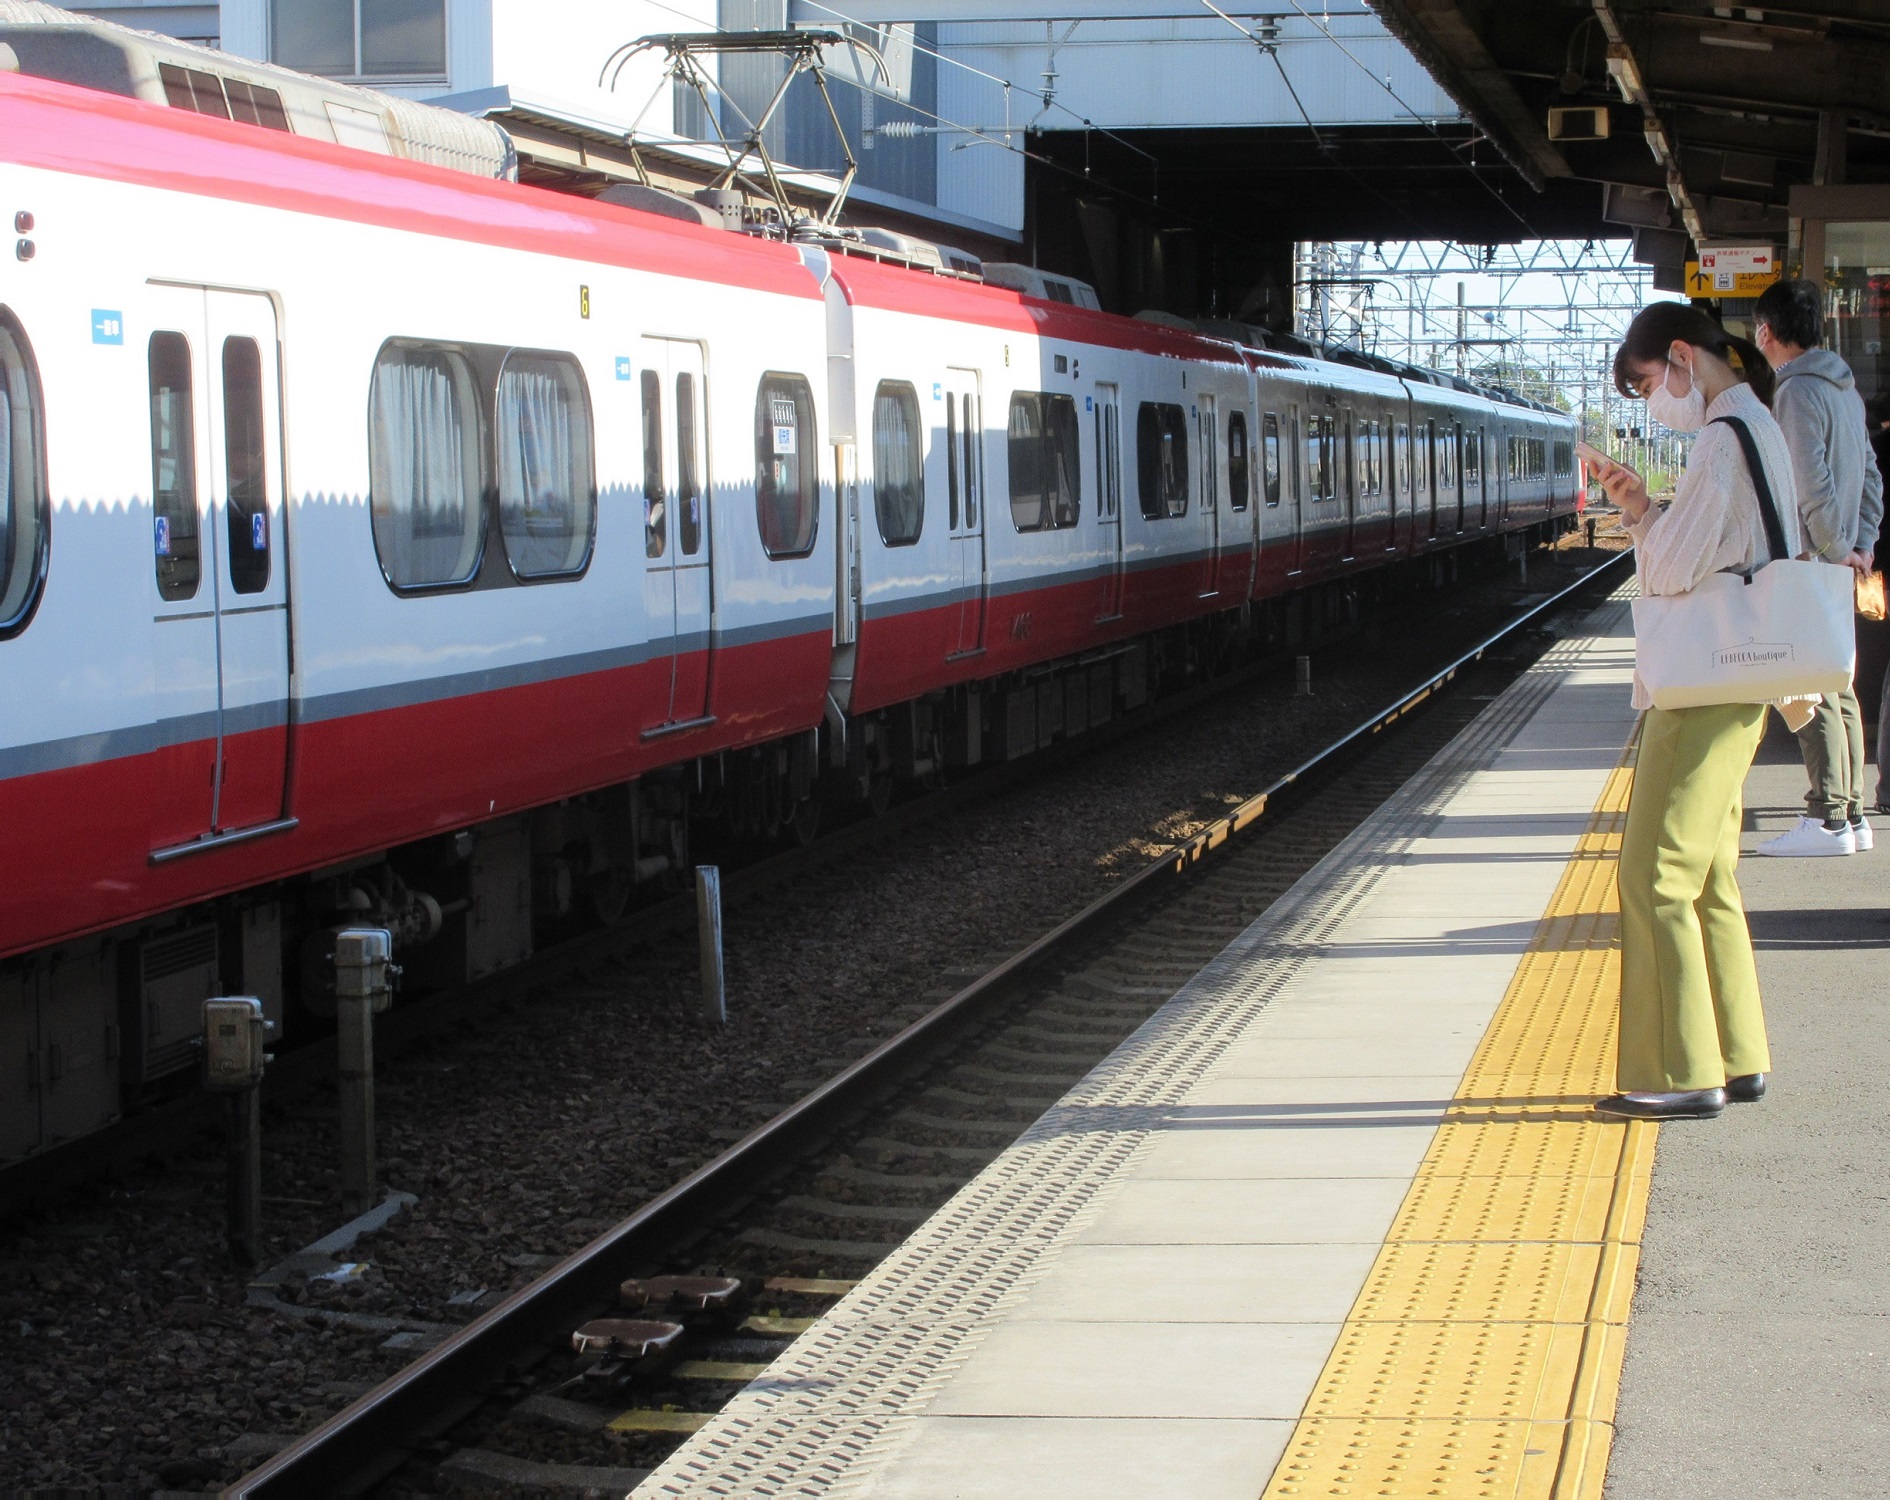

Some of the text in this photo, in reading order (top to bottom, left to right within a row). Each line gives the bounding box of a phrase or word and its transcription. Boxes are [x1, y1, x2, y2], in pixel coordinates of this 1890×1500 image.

[1739, 282, 1770, 290] Elevato
[582, 287, 588, 316] 6
[1753, 651, 1788, 662] boutique
